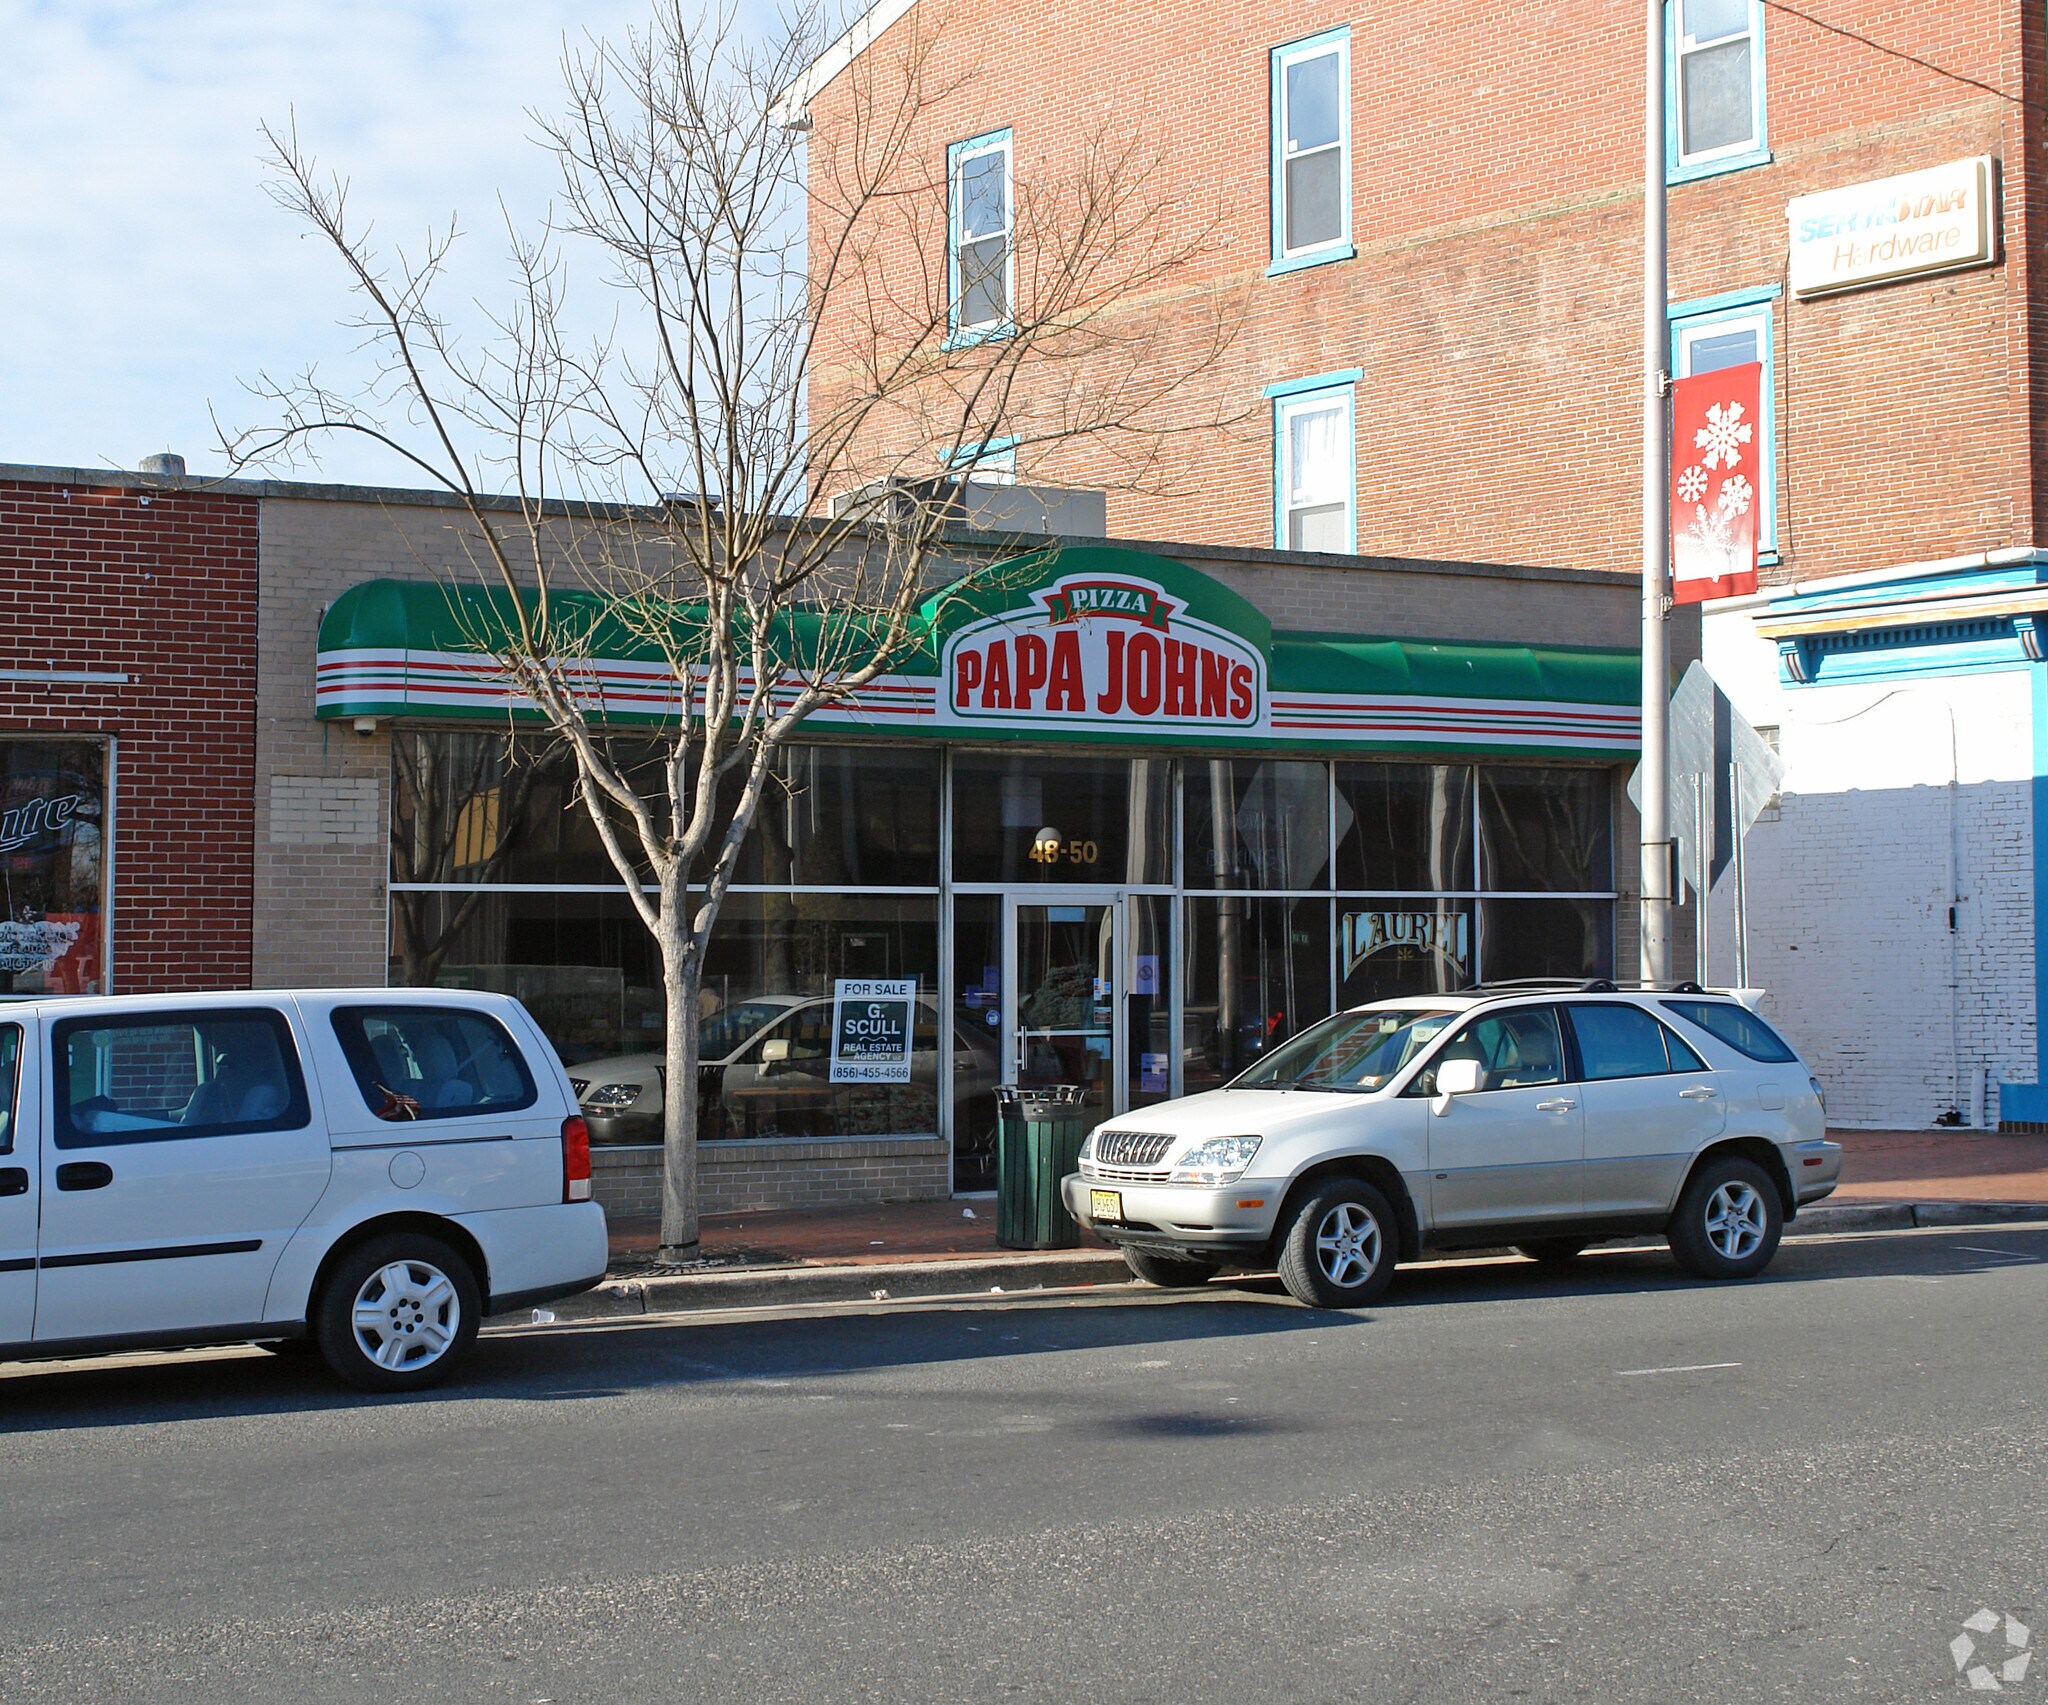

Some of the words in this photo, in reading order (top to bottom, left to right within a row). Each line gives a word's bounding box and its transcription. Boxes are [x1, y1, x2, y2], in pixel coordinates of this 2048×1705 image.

[1832, 226, 1961, 271] Hardware
[1071, 587, 1149, 614] PIZZA
[956, 629, 1087, 712] PAPA
[1097, 629, 1253, 720] JOHN'S
[1028, 839, 1098, 864] 48-50
[844, 983, 871, 995] FOR
[875, 984, 908, 996] SALE
[867, 1003, 885, 1019] G.
[844, 1019, 901, 1035] SCULL
[843, 1043, 867, 1052] REAL
[869, 1043, 902, 1052] ESTATE
[853, 1052, 892, 1061] AGENCY
